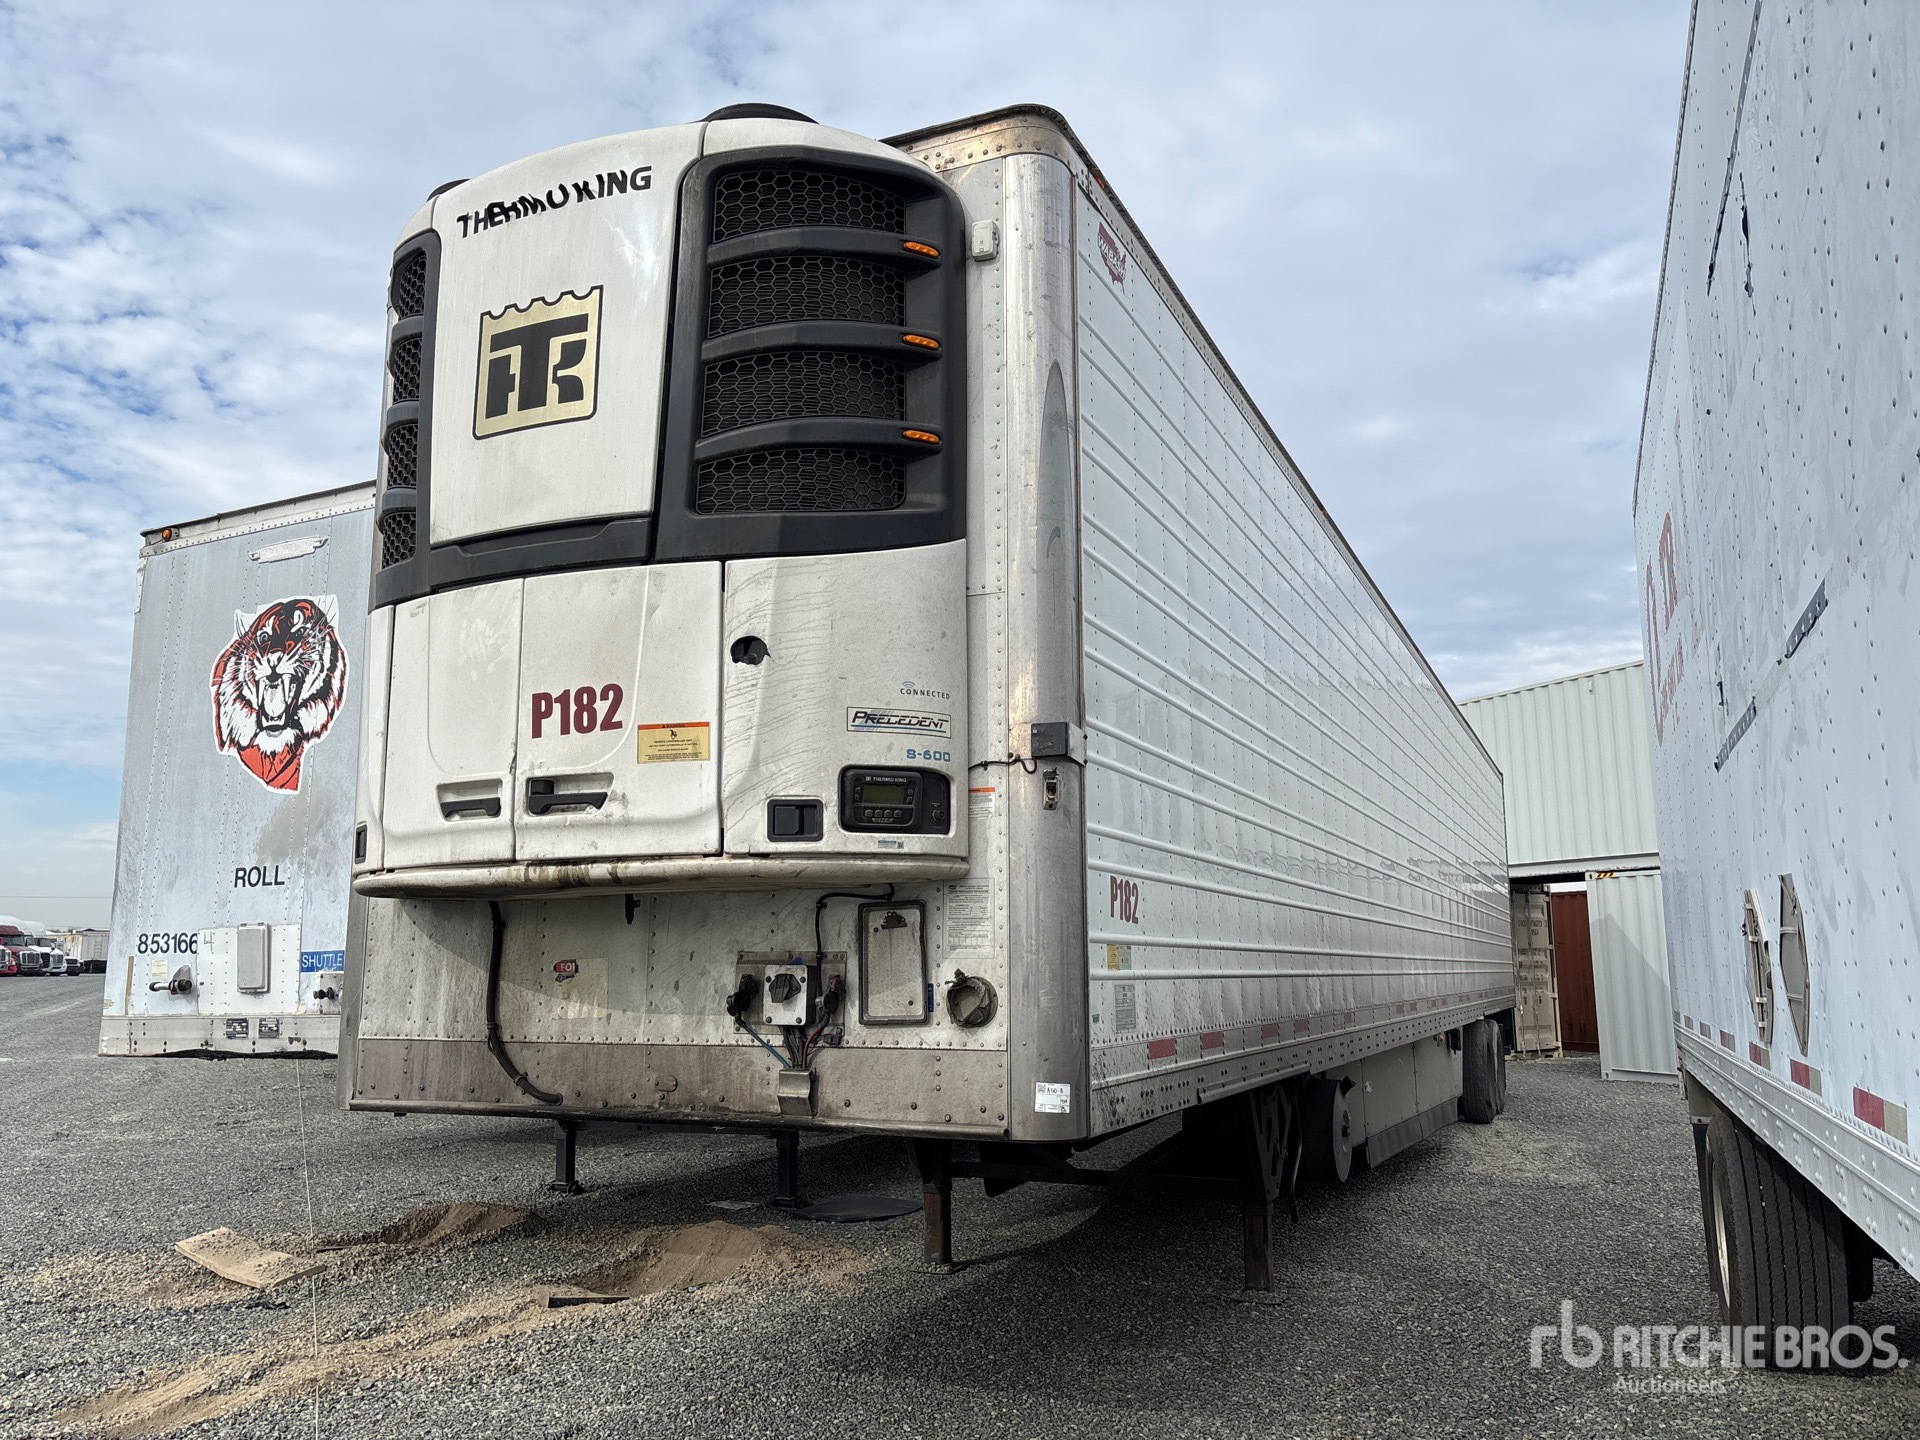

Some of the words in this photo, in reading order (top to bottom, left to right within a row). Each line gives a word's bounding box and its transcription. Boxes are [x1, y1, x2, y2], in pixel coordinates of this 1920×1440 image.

[572, 166, 652, 204] KING
[900, 688, 950, 699] CONNECTED
[531, 683, 624, 739] P182
[852, 711, 949, 728] PRECEDENT
[906, 748, 951, 762] S-600
[234, 865, 285, 888] ROLL
[1110, 875, 1139, 925] P182
[301, 953, 343, 968] SHUTTLE
